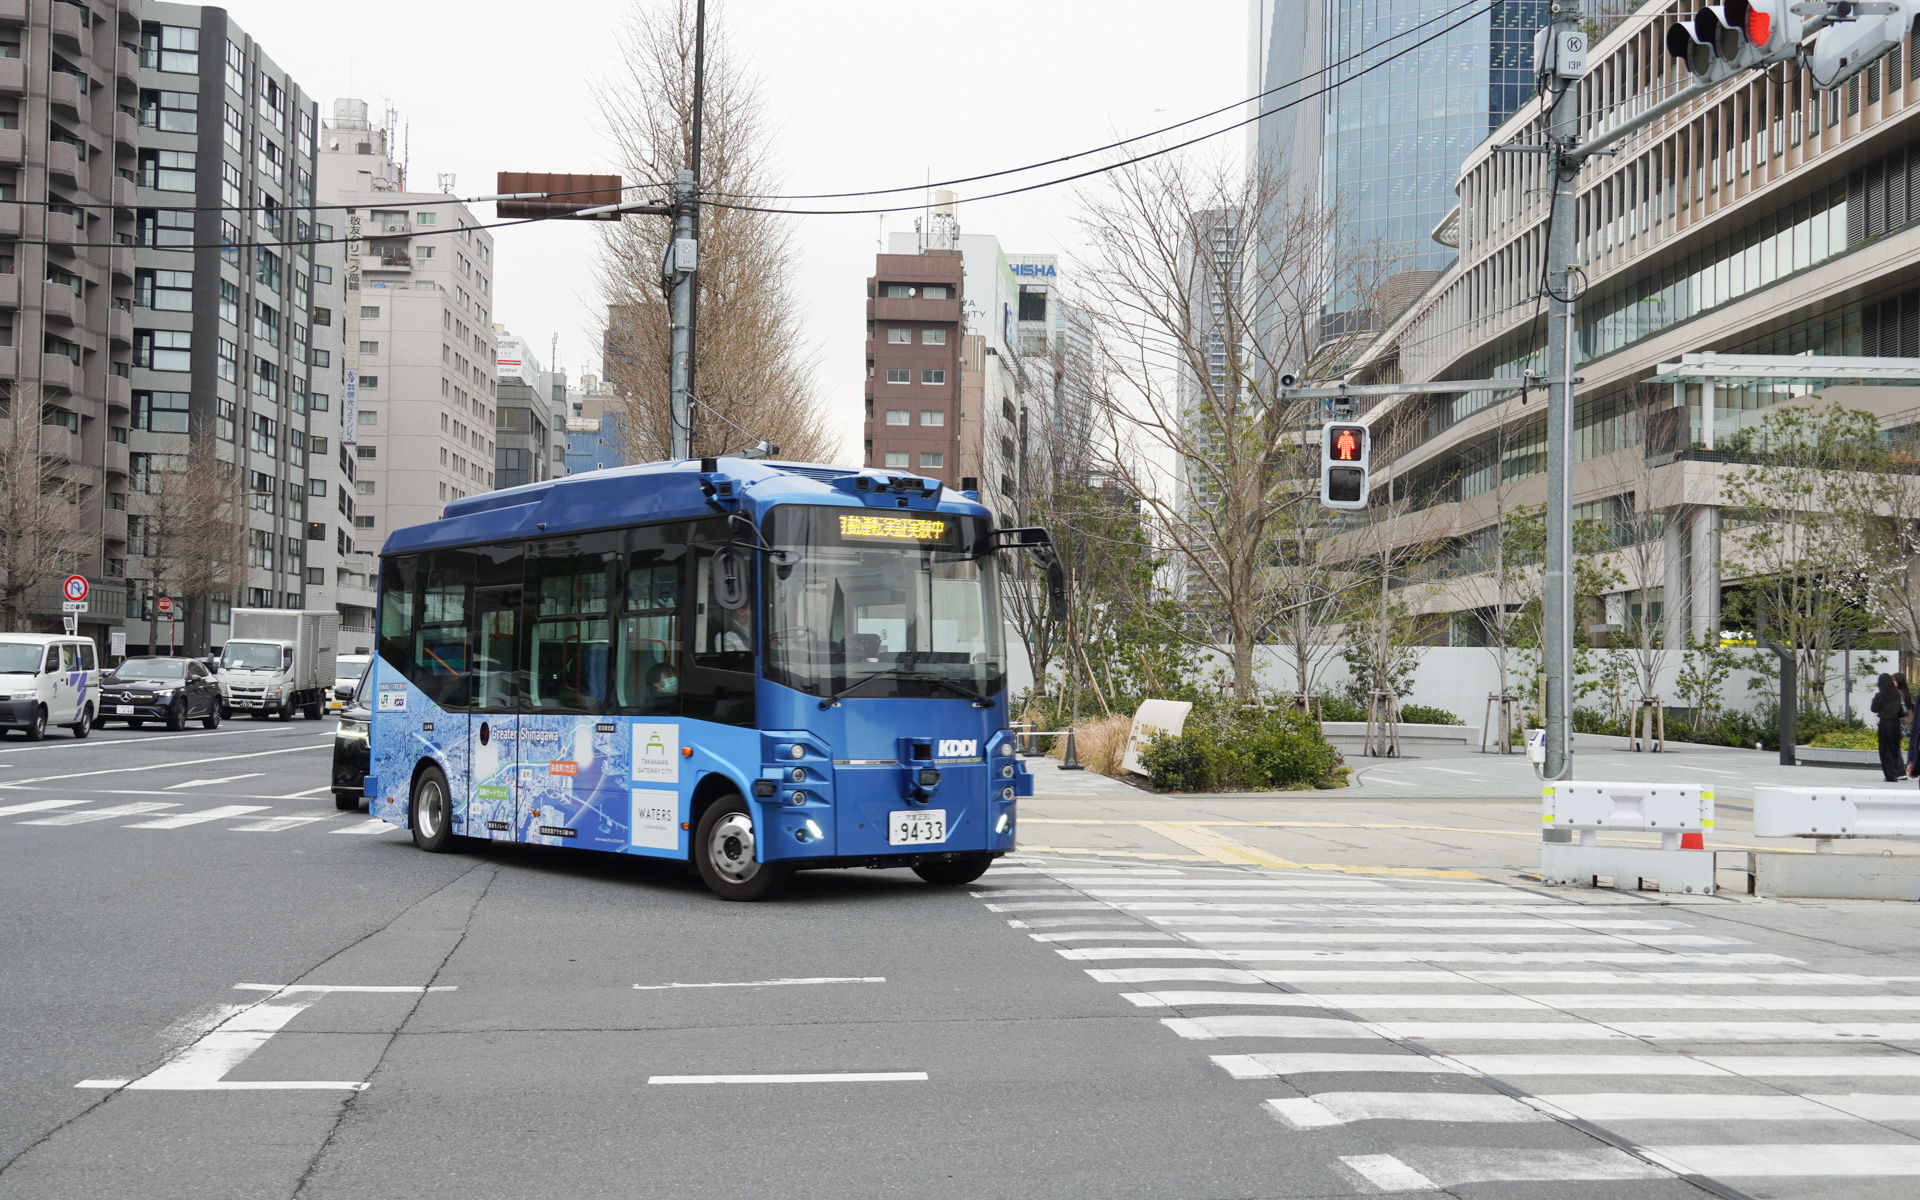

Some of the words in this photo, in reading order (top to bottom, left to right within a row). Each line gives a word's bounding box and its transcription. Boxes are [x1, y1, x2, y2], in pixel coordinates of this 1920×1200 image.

[492, 726, 518, 740] Greater
[520, 727, 560, 744] Shinagawa
[938, 740, 977, 757] KDDI
[641, 758, 669, 766] TAKANAWA
[638, 807, 672, 822] WATERS
[918, 813, 931, 821] 230
